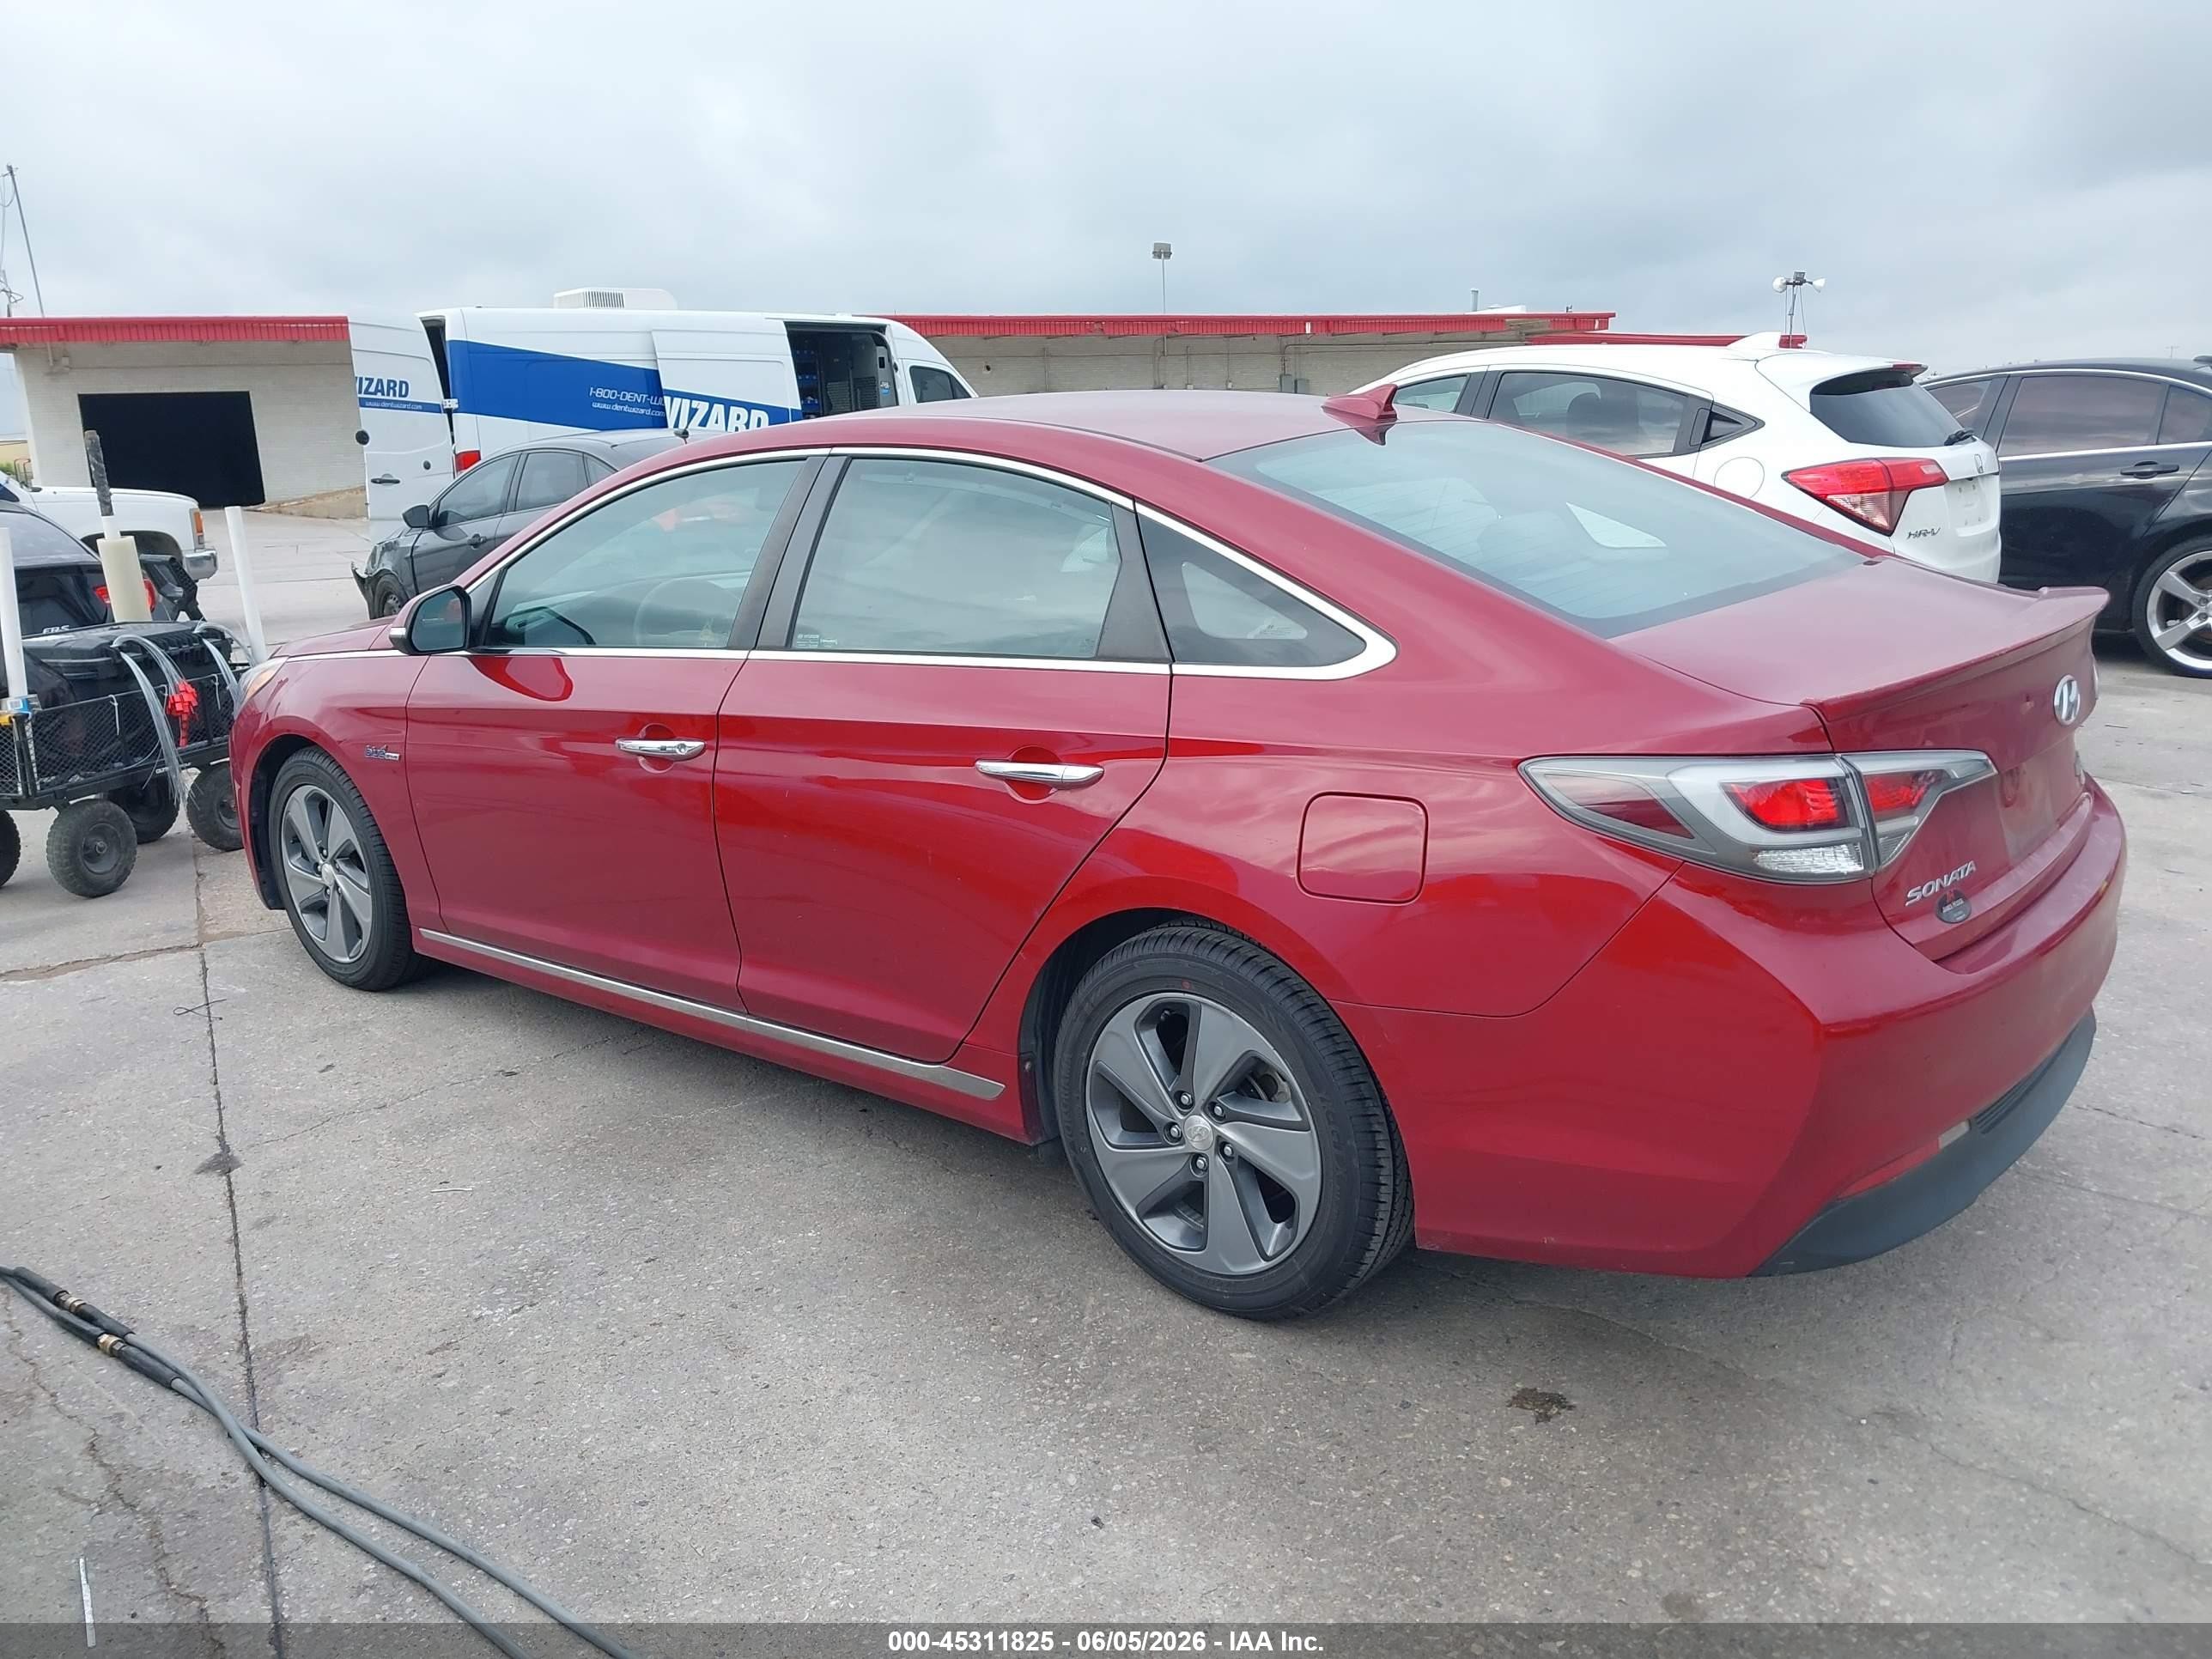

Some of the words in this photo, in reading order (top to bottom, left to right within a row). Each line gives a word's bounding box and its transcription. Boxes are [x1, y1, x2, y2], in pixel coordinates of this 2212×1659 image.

[355, 376, 410, 398] IZARD
[1906, 527, 1941, 539] HR-V
[1905, 860, 1977, 907] SONATA
